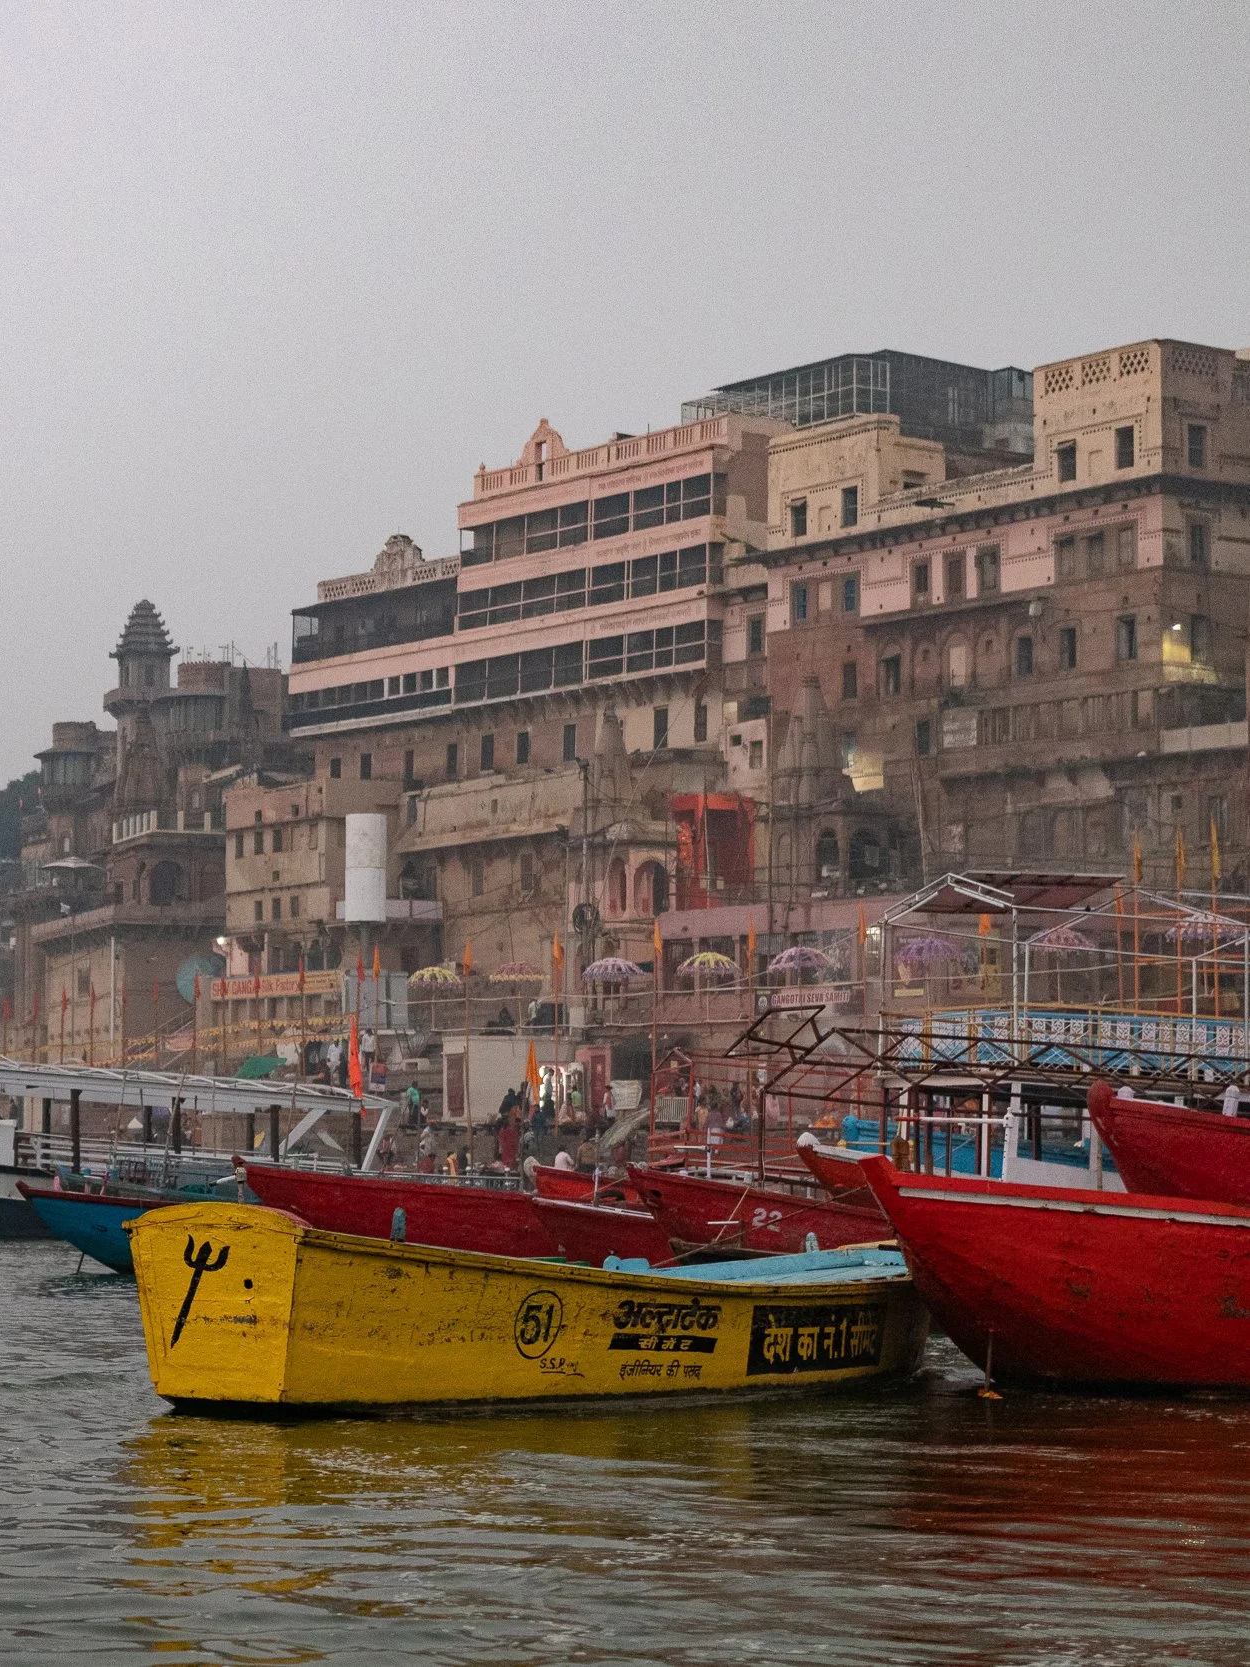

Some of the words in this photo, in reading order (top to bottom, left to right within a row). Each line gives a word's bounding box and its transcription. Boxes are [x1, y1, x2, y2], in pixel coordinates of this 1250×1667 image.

[807, 992, 824, 1003] SEVA
[825, 990, 850, 1002] SAMITI
[752, 1207, 782, 1233] 22
[519, 1304, 554, 1345] 51
[762, 1313, 794, 1365] देश
[797, 1326, 820, 1361] का
[666, 1359, 681, 1377] की
